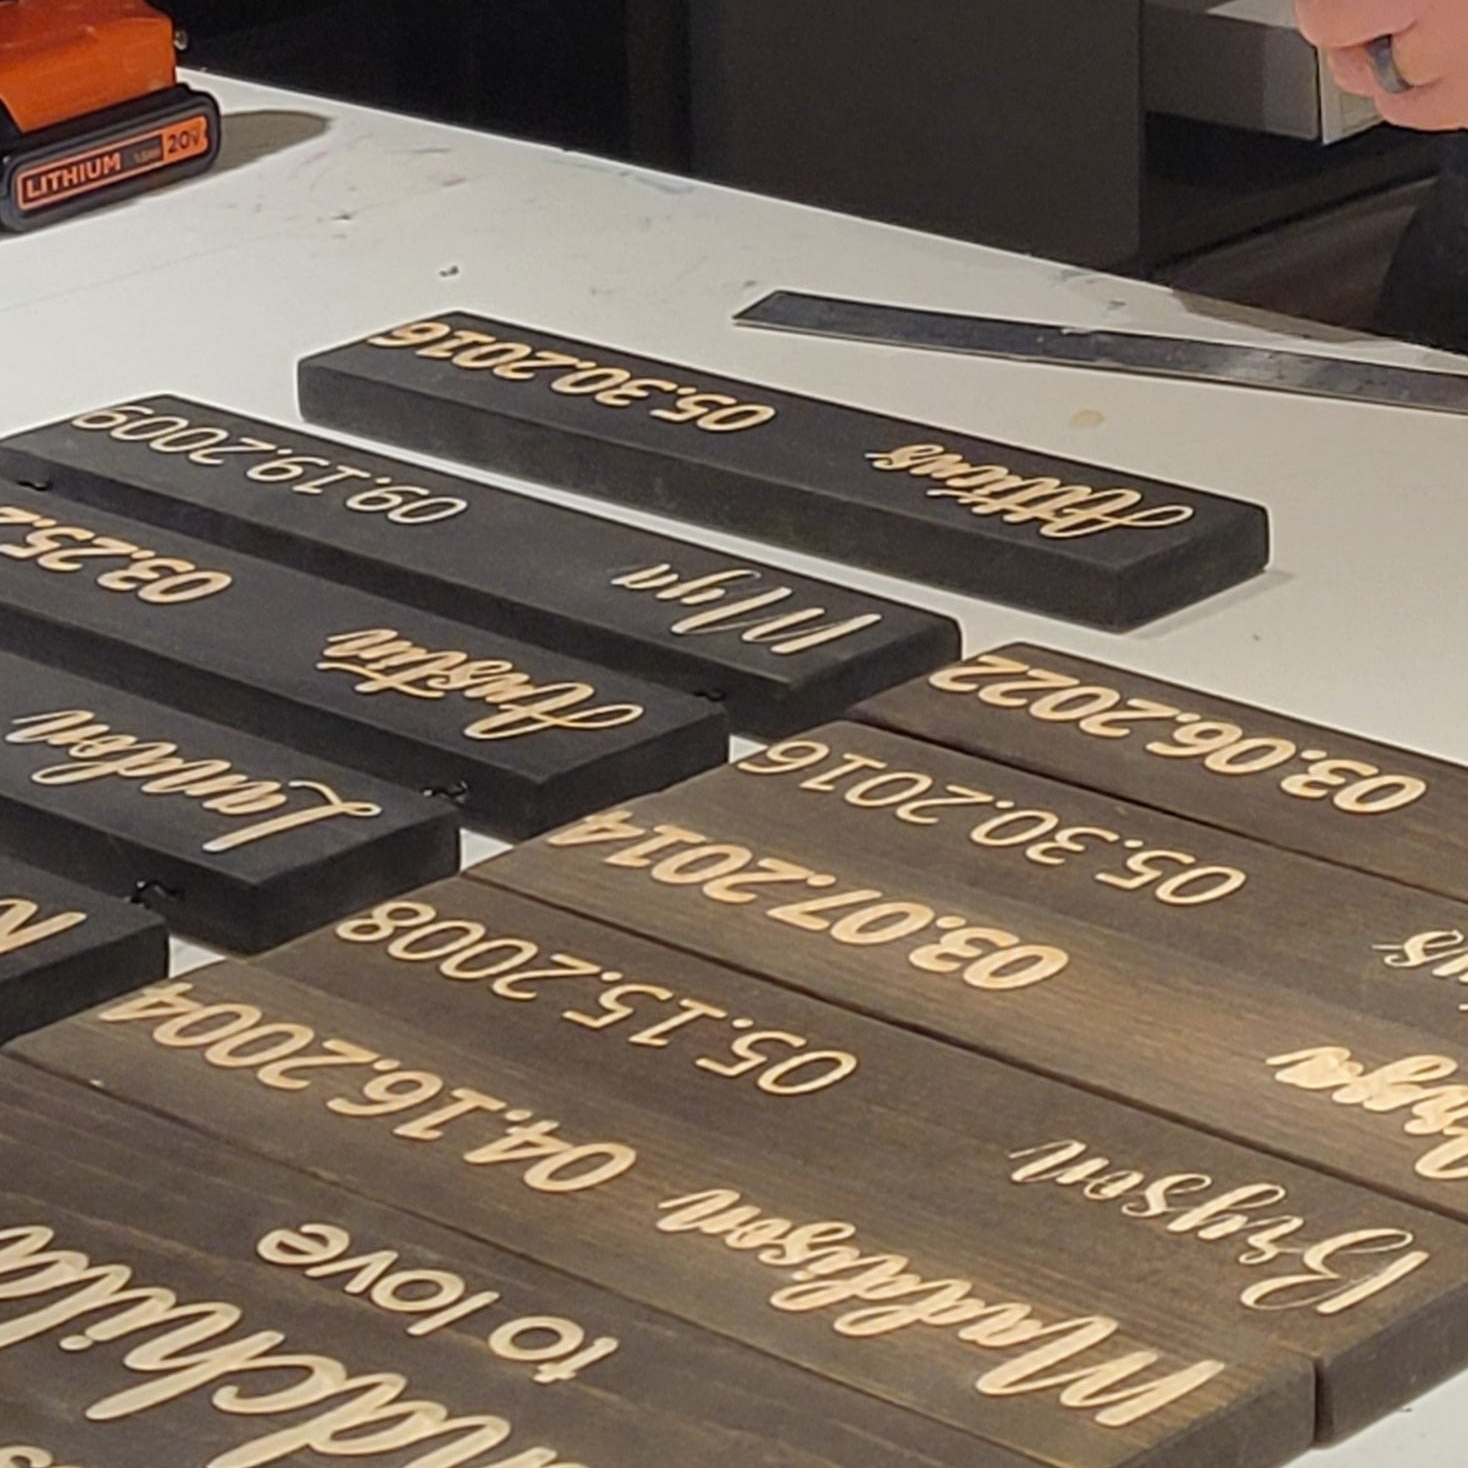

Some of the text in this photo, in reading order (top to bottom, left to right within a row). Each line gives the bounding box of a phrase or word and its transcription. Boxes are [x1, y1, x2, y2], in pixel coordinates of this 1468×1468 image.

[26, 151, 122, 199] LITHIUM
[367, 321, 776, 432] 05.30.2016
[71, 404, 468, 524] 09.19.2009
[317, 628, 644, 739] Austin
[928, 654, 1428, 815] 03.06.2022
[3, 708, 382, 853] Landon
[737, 739, 1247, 906] 05.30.2016
[547, 810, 1069, 990] 03.07.2014
[336, 900, 1430, 1315] Bryson 05.15.2008
[99, 982, 1226, 1427] Maddison 04.16.2004
[256, 1223, 619, 1384] to love
